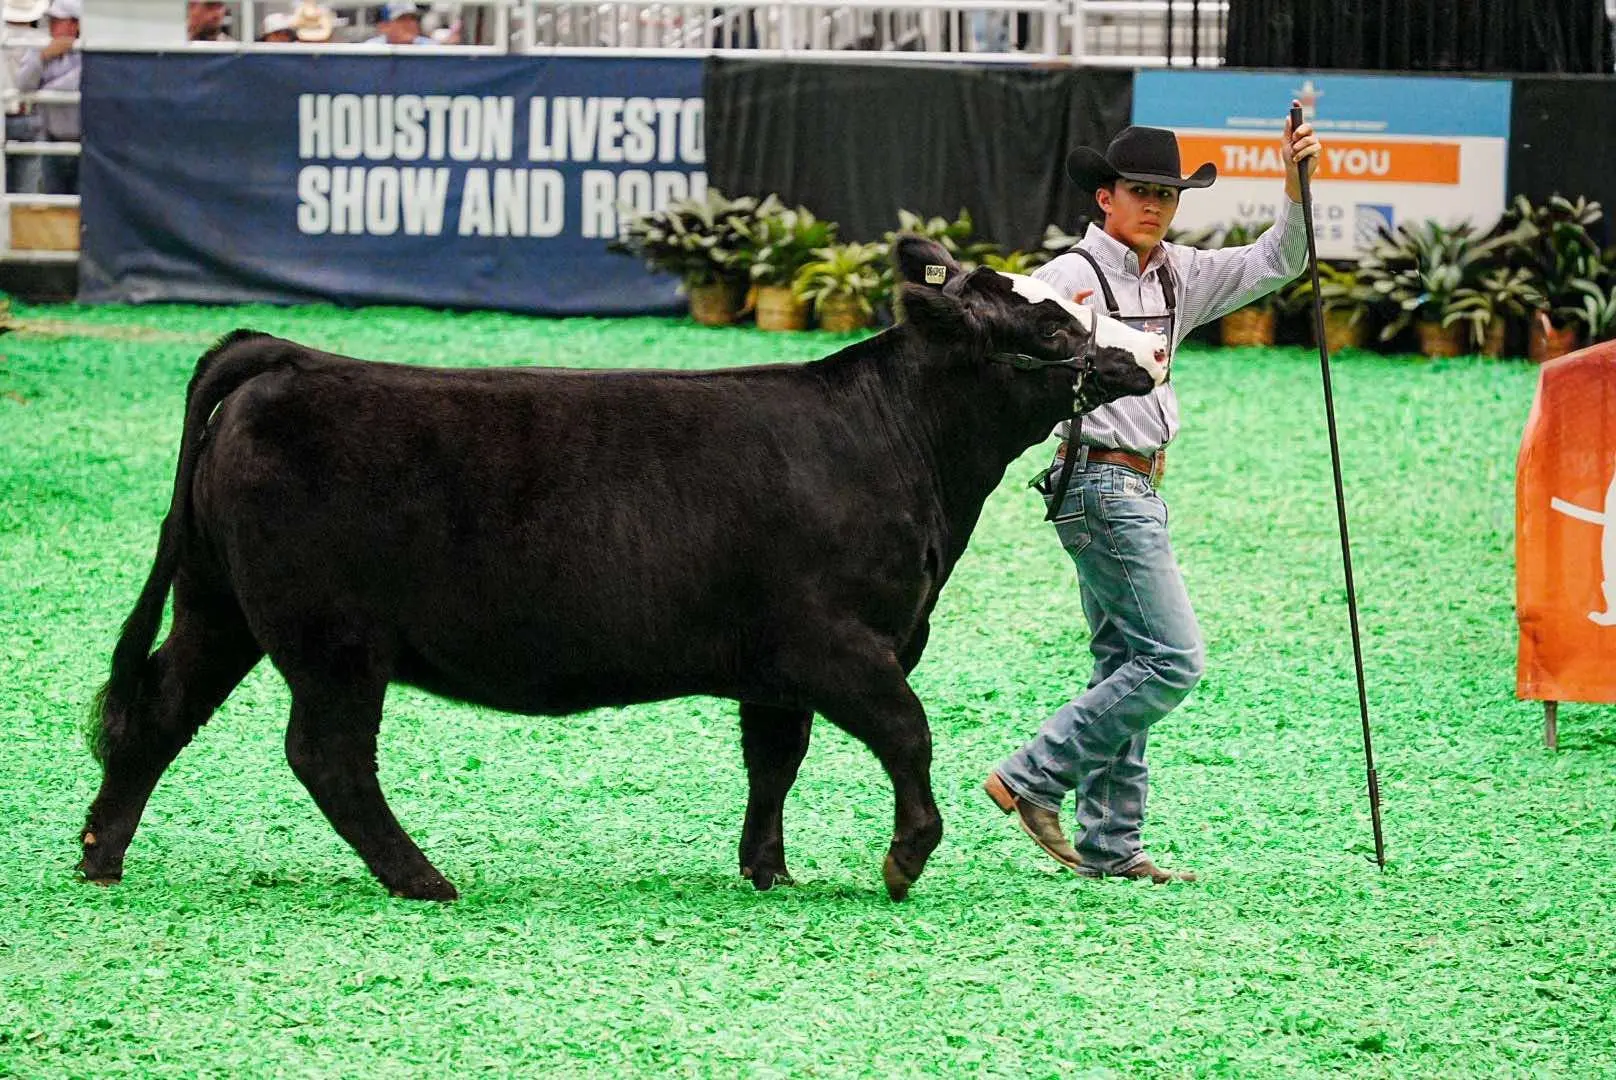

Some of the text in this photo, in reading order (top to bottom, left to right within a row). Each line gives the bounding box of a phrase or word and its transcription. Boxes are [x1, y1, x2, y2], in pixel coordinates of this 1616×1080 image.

[297, 93, 706, 164] HOUSTON LIVESTO
[1221, 144, 1391, 176] THA YOU
[296, 165, 450, 235] SHOW
[458, 167, 565, 238] AND
[1239, 203, 1345, 219] UNED
